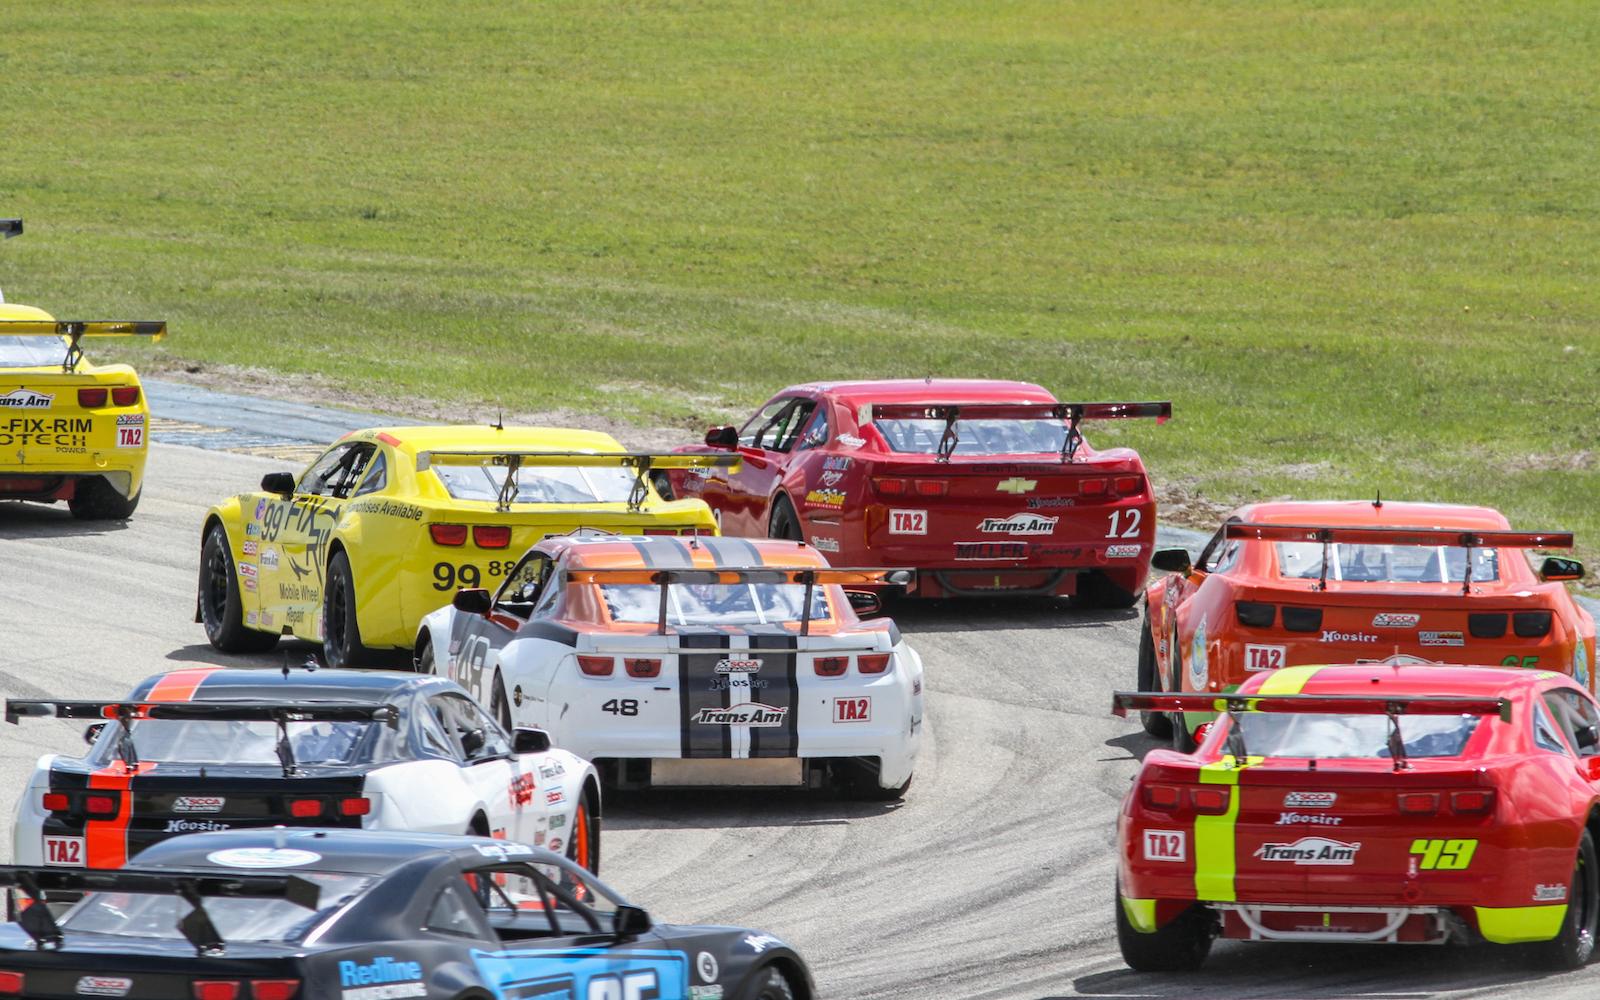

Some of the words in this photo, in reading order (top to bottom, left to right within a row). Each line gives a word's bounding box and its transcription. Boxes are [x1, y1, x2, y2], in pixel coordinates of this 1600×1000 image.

[25, 395, 50, 407] Am
[120, 429, 141, 445] TA2
[380, 501, 423, 521] Available
[261, 503, 284, 543] 99
[893, 513, 923, 531] TA2
[983, 519, 1025, 532] Trans
[1027, 519, 1053, 531] Am
[1105, 508, 1141, 539] 12
[956, 543, 1025, 559] MILLER
[432, 561, 481, 592] 99
[1319, 630, 1378, 643] Hoosier
[1249, 648, 1282, 669] TA2
[602, 699, 638, 716] 48
[701, 709, 748, 723] Trans
[751, 709, 782, 723] Am
[837, 700, 868, 720] TA2
[163, 819, 230, 832] Hoosier
[1274, 812, 1343, 825] Hoosier
[47, 840, 81, 862] TA2
[1149, 834, 1180, 857] TA2
[1262, 844, 1315, 860] Trans
[1316, 845, 1353, 860] Am
[1409, 839, 1479, 870] 49
[338, 956, 424, 987] Redline
